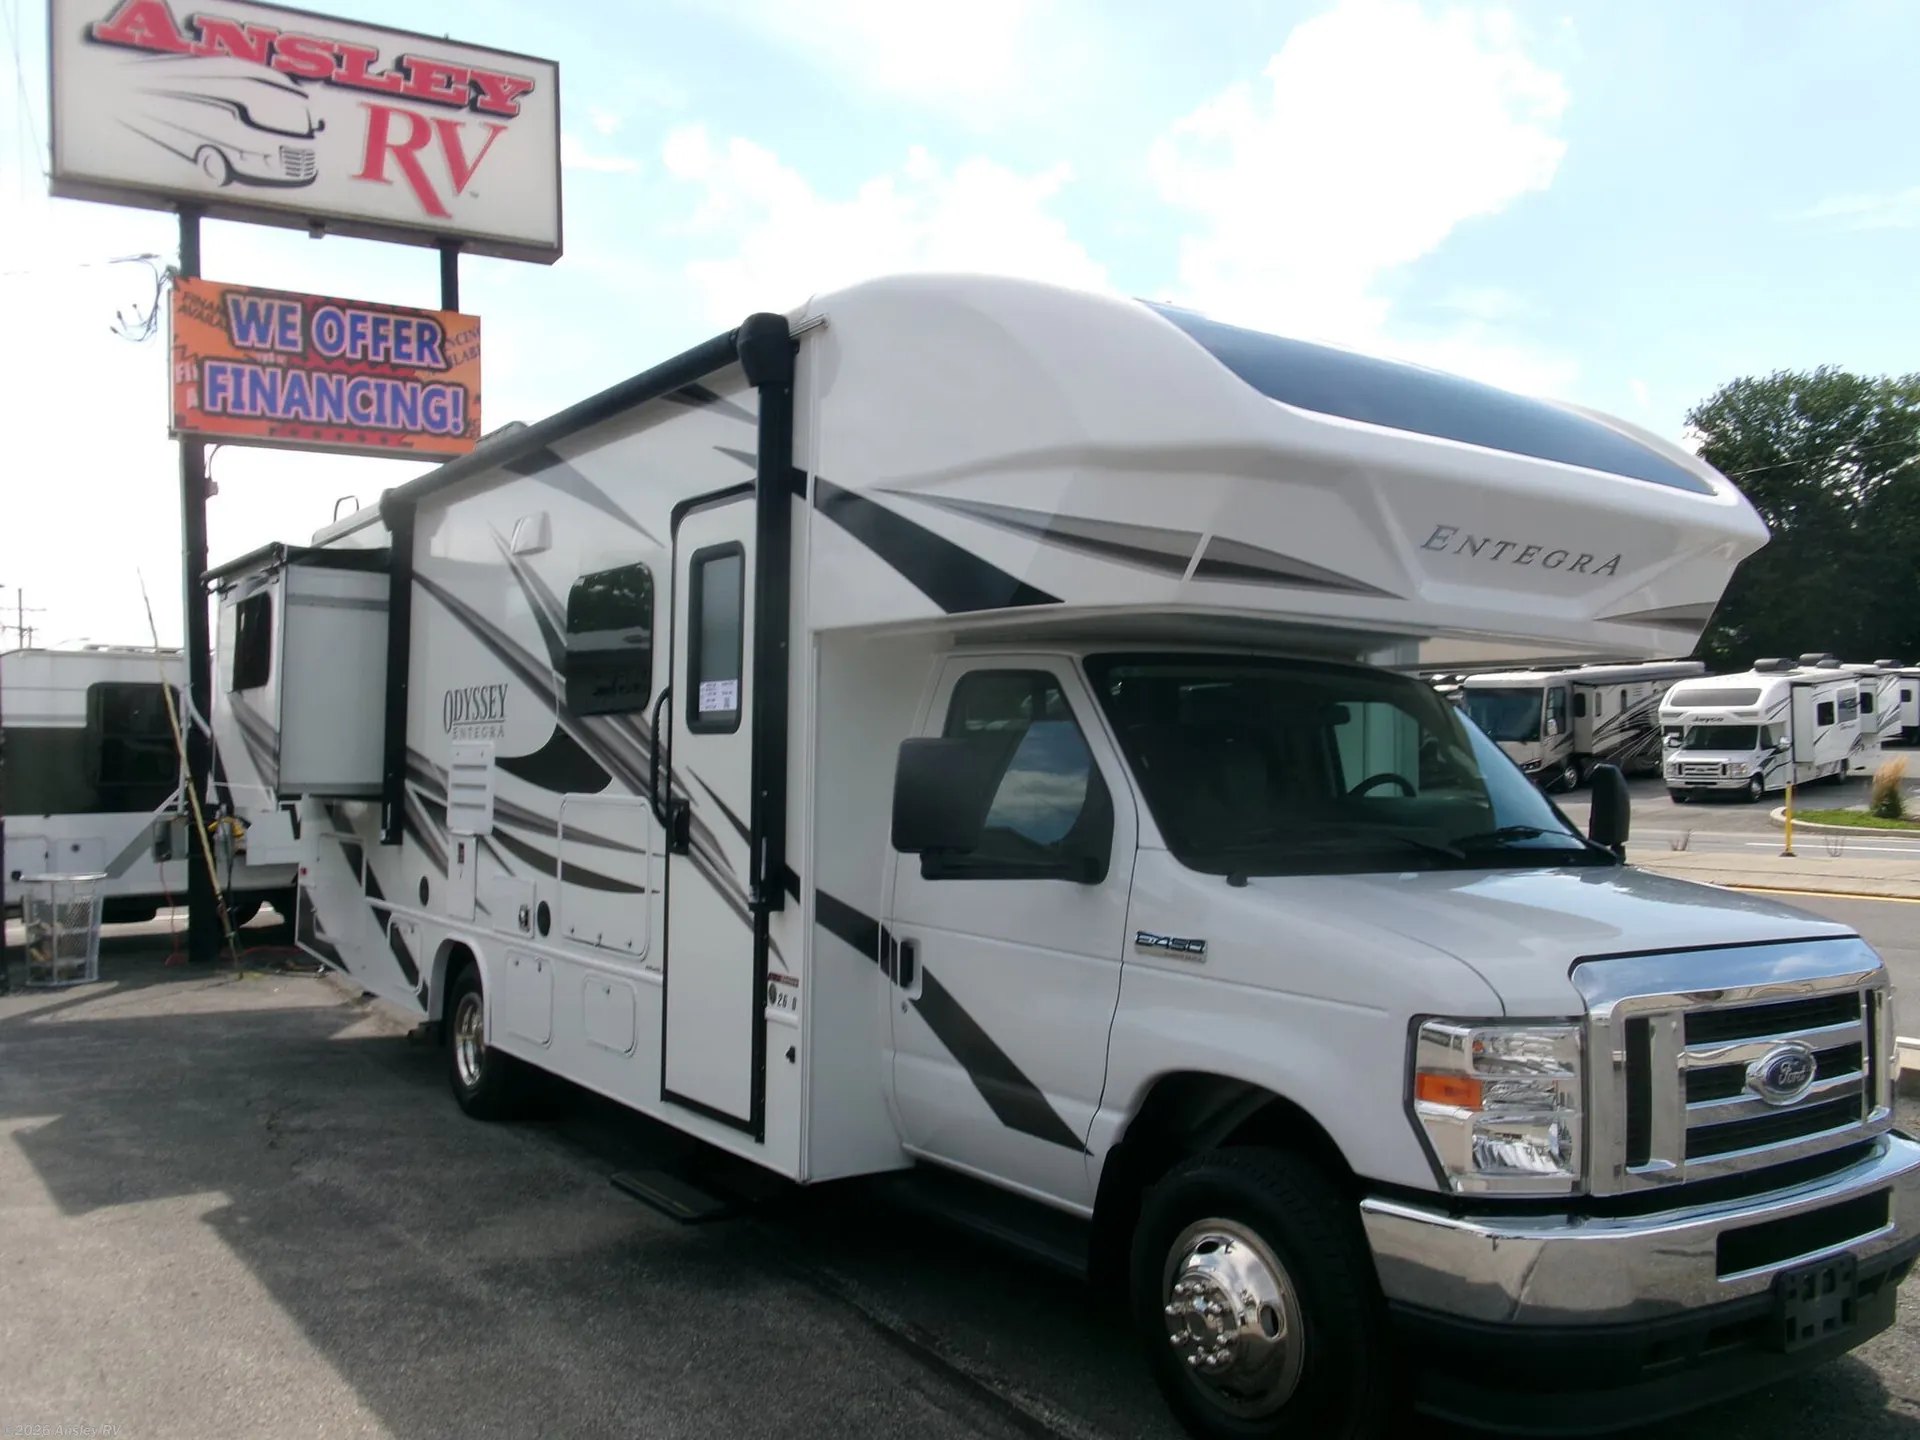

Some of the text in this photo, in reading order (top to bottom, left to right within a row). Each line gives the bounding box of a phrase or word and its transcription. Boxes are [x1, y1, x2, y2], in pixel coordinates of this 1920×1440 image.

[90, 0, 534, 117] ANSLEY
[350, 101, 508, 219] RV
[225, 293, 303, 352] WE
[311, 305, 447, 369] OFFER
[203, 360, 466, 436] FINANCING!
[1420, 524, 1623, 577] ENTEGRA
[443, 682, 509, 735] ODYSSEY
[1778, 1060, 1807, 1085] Ford
